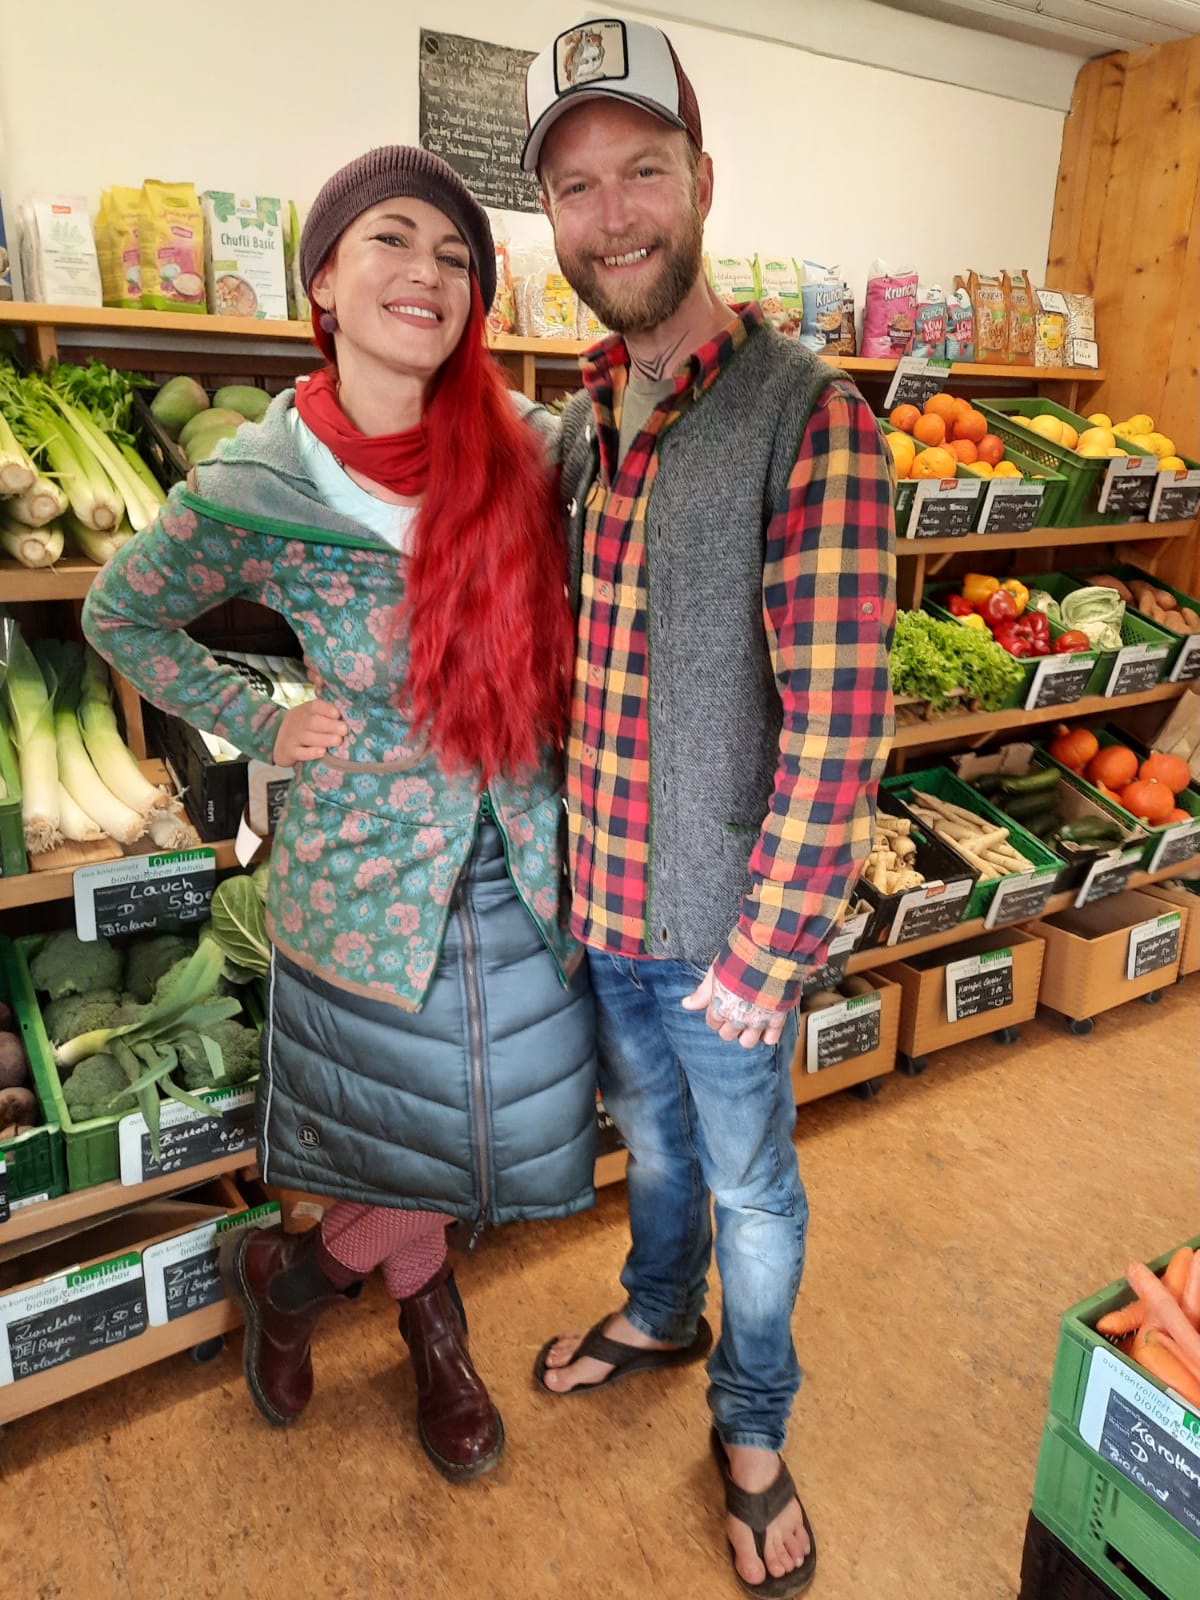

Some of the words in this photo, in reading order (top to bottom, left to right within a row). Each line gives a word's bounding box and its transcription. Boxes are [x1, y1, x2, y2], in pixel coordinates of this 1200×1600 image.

[220, 232, 250, 248] Chufli
[252, 236, 275, 250] Basic
[884, 281, 917, 301] Krunchy
[923, 319, 943, 332] LOW
[152, 851, 206, 868] Qualität
[130, 877, 194, 900] Lauch
[117, 903, 135, 917] D
[103, 919, 158, 937] Bioland
[221, 1206, 272, 1234] Qualität
[71, 1259, 130, 1289] Qualität
[96, 1270, 131, 1287] Anbau
[133, 1301, 143, 1315] €
[15, 1312, 82, 1342] Zwiebeln
[19, 1347, 72, 1375] Bioland
[1102, 1357, 1119, 1373] aus
[1119, 1368, 1174, 1415] kontrolliert-
[1133, 1391, 1200, 1451] biologische
[1129, 1440, 1149, 1464] D
[1109, 1448, 1170, 1502] Bioland
